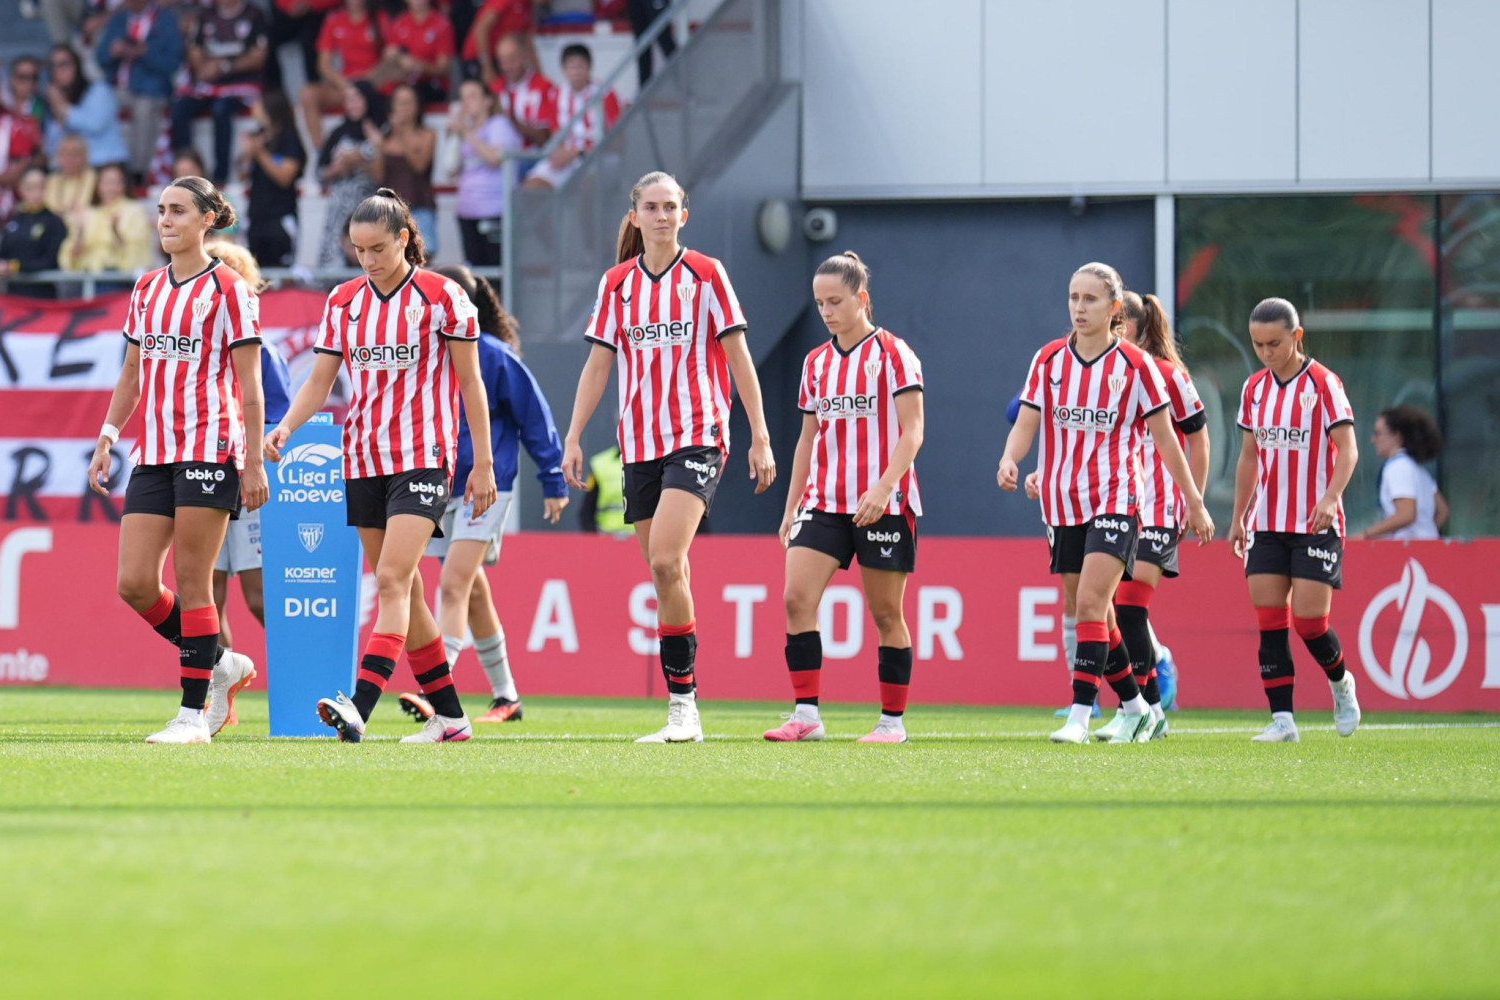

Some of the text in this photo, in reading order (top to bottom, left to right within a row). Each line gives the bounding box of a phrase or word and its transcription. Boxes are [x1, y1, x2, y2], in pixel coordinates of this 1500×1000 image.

[288, 468, 340, 487] Liga F
[278, 489, 343, 503] moeve
[284, 597, 337, 618] DIGI
